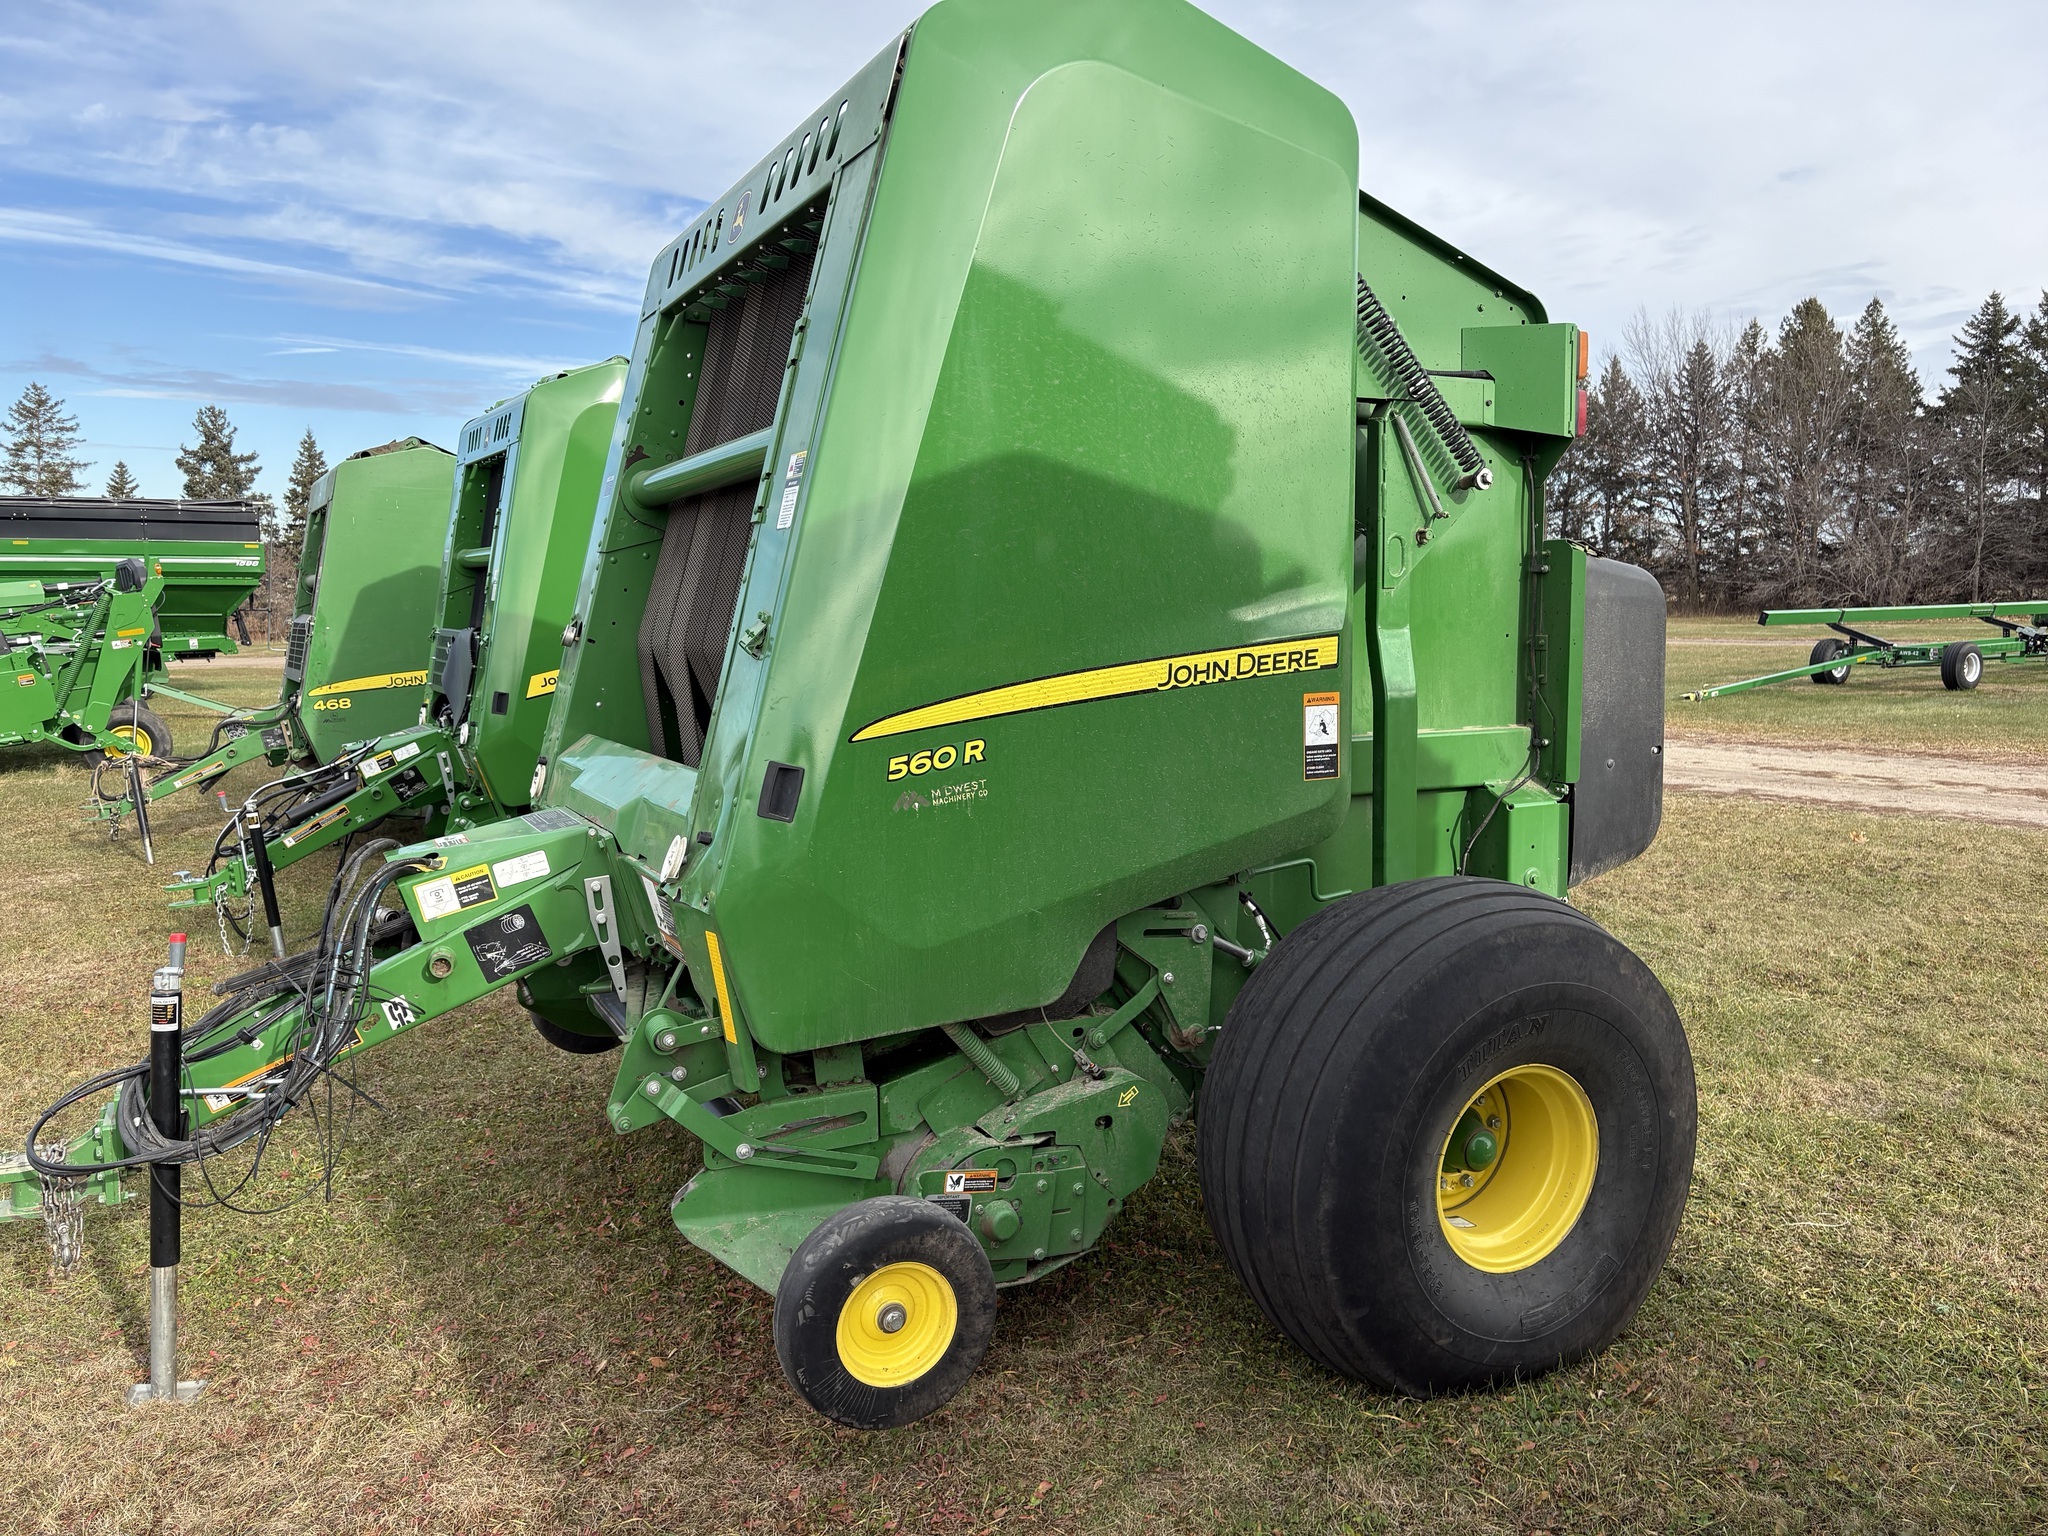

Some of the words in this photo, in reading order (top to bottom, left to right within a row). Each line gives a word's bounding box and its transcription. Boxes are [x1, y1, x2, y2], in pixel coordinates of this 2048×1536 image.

[1157, 659, 1230, 688] JOHN
[1236, 648, 1319, 676] DEERE
[386, 675, 424, 687] JOHN
[541, 676, 558, 688] JO
[313, 697, 352, 711] 468
[887, 744, 959, 782] 560
[962, 738, 987, 766] R
[931, 779, 987, 798] MDWEST
[932, 791, 976, 806] MACHINERY
[978, 789, 988, 797] CO
[460, 868, 484, 881] CAUTION
[1457, 1013, 1550, 1082] TITAN
